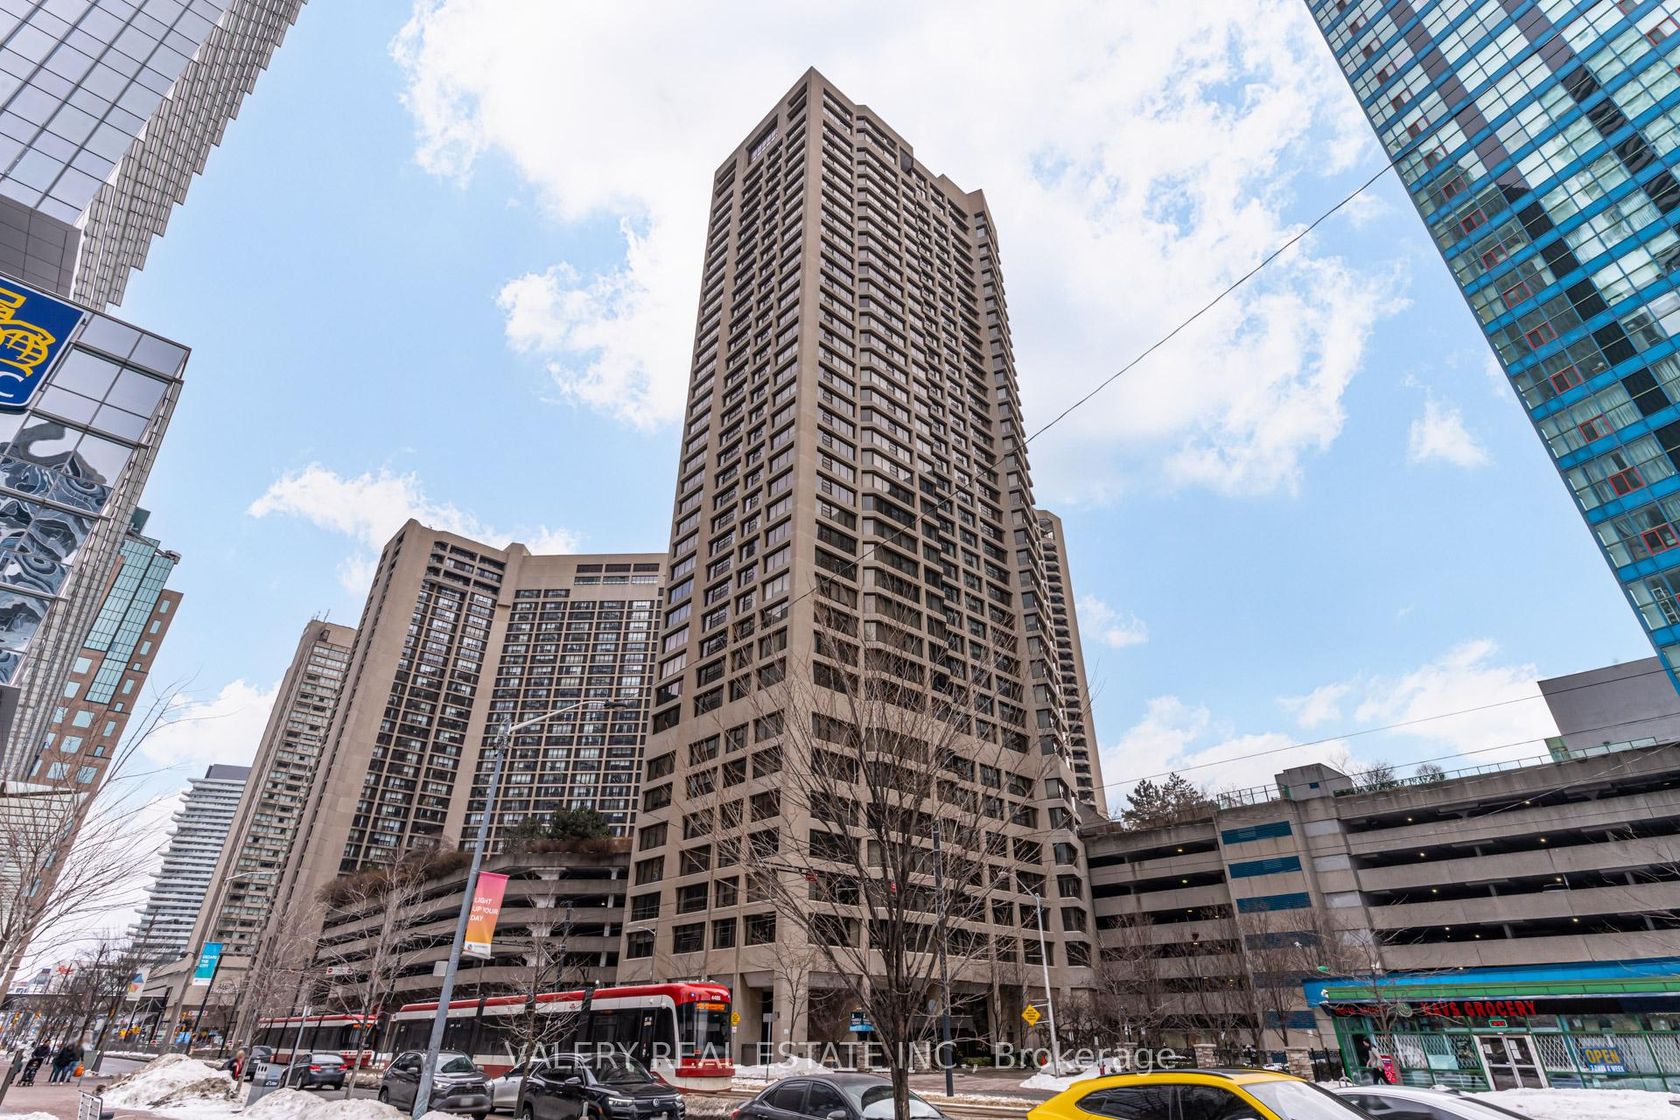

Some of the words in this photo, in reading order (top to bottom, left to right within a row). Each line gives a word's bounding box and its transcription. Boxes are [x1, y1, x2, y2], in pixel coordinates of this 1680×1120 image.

[474, 897, 493, 905] LIGHT
[469, 914, 484, 922] DAY
[1463, 1000, 1537, 1017] GROCERY
[1585, 1049, 1622, 1064] OPEN
